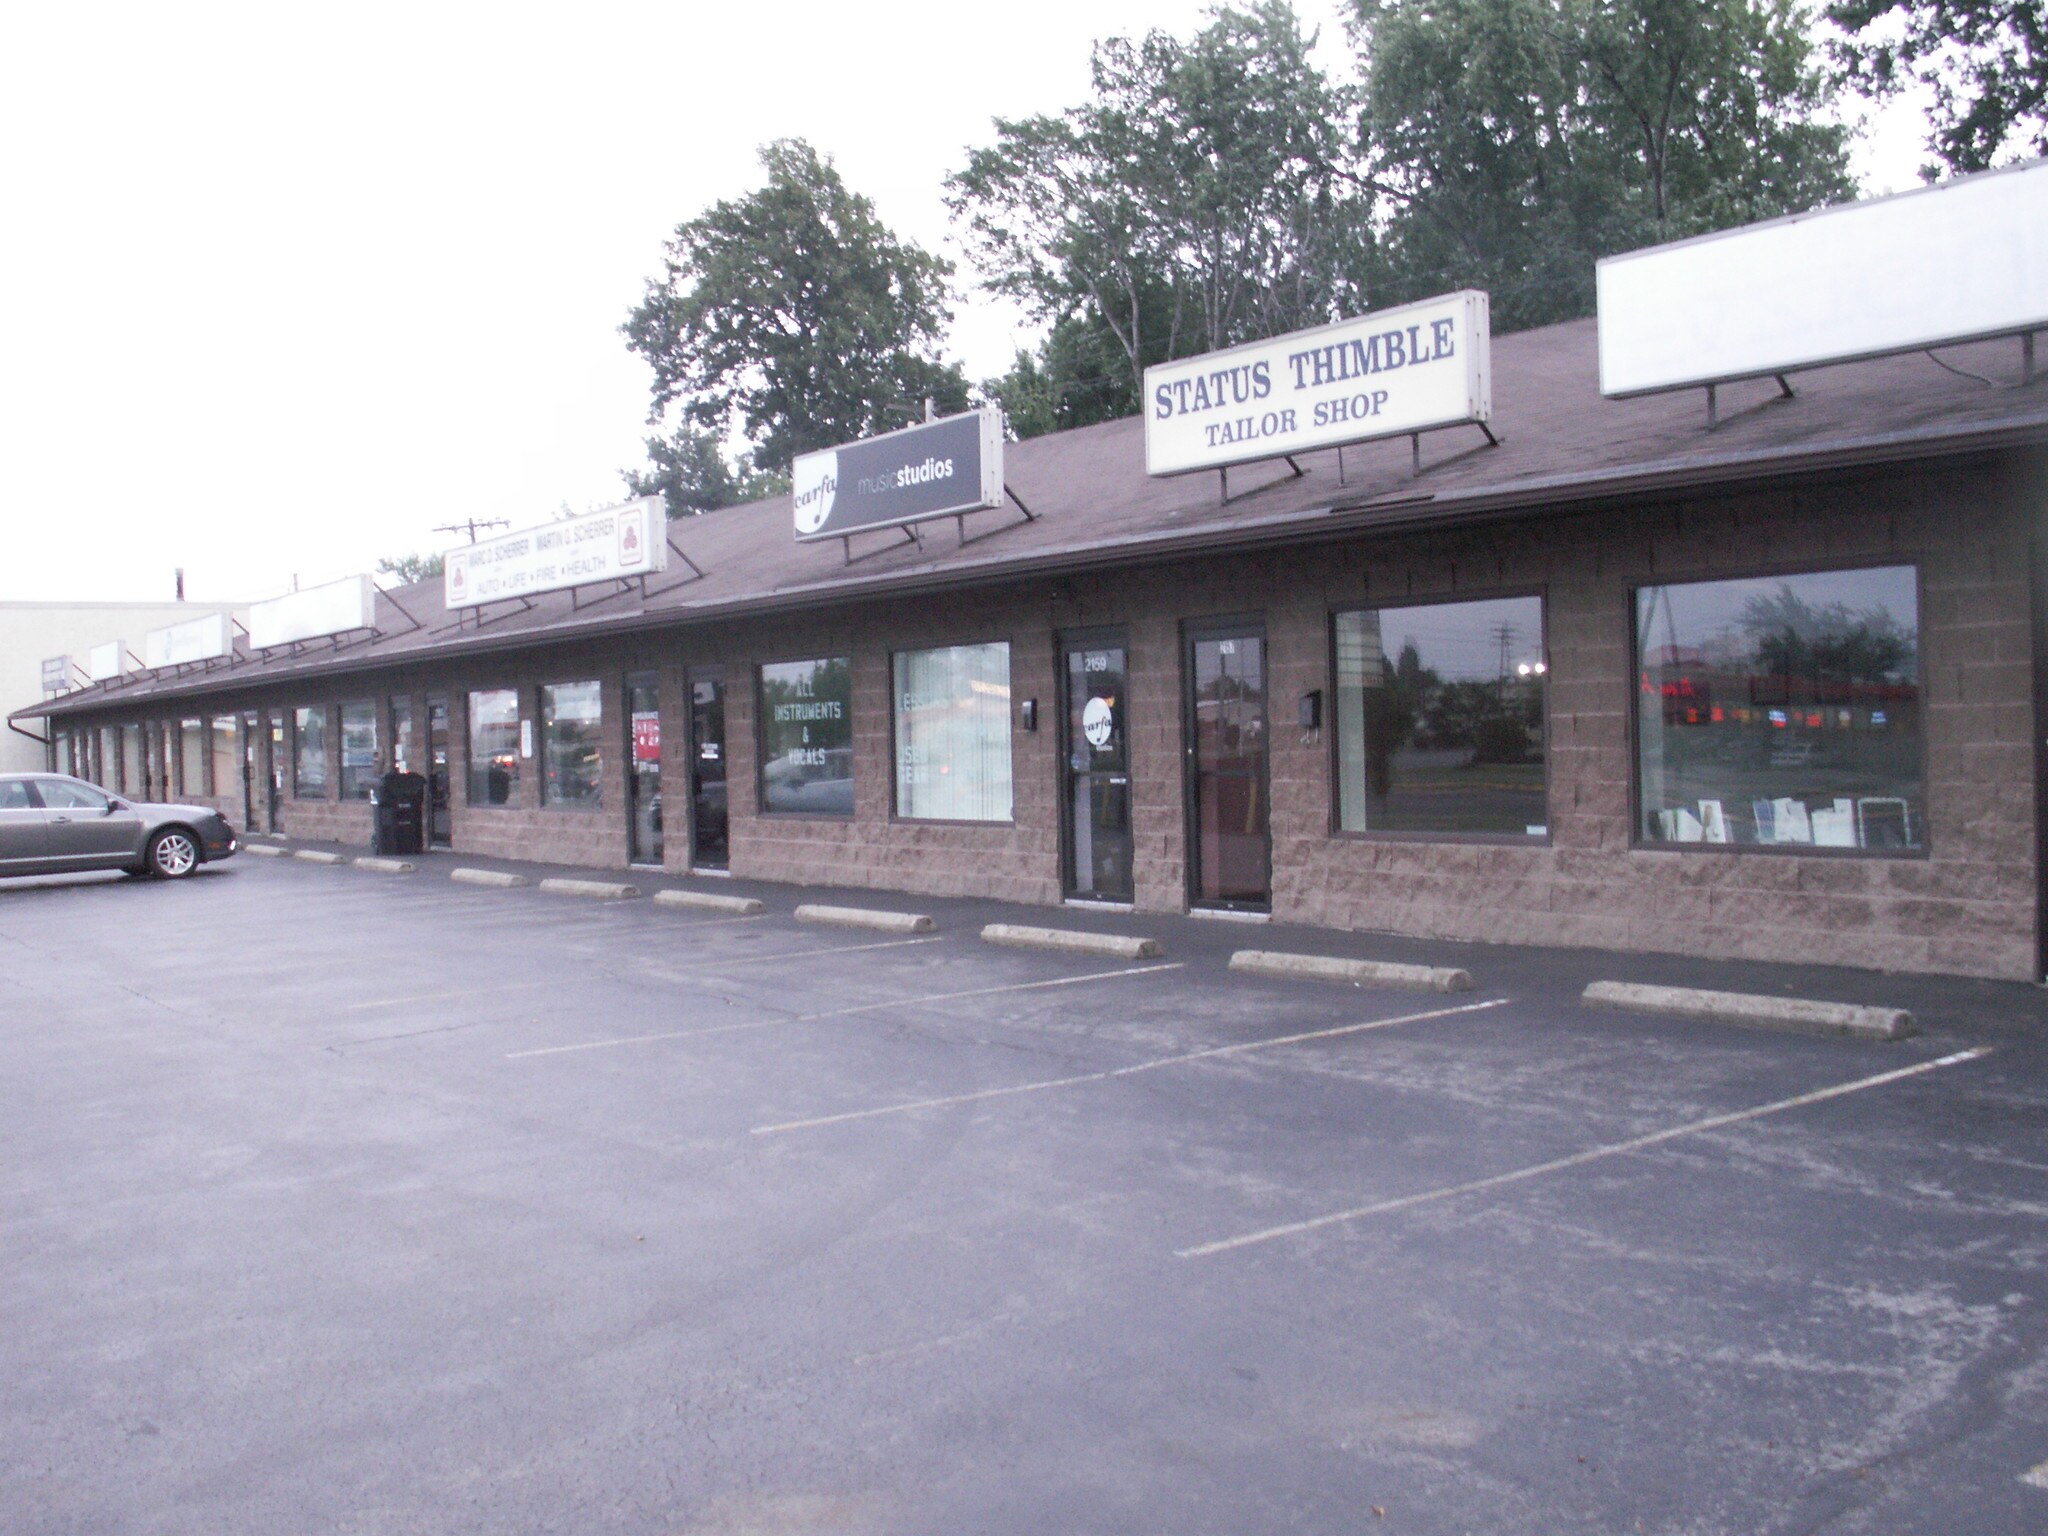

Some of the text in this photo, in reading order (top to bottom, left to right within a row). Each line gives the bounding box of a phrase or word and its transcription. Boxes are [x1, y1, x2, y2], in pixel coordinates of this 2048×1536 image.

[1156, 318, 1454, 420] STATUS THIMBLE
[1205, 390, 1389, 447] TAILOR SHOP
[468, 550, 486, 568] MARC
[536, 530, 563, 551] MARTIN
[574, 518, 615, 541] SCHERRER
[478, 578, 500, 595] AUTO
[509, 573, 527, 589] LIFE
[536, 566, 556, 583] FIRE
[567, 555, 606, 576] HEALTH
[797, 680, 815, 697] ALL
[774, 701, 841, 721] INSTRUMENTS
[802, 726, 809, 743] &
[1085, 716, 1112, 742] arfa
[787, 748, 826, 766] VOCALS
